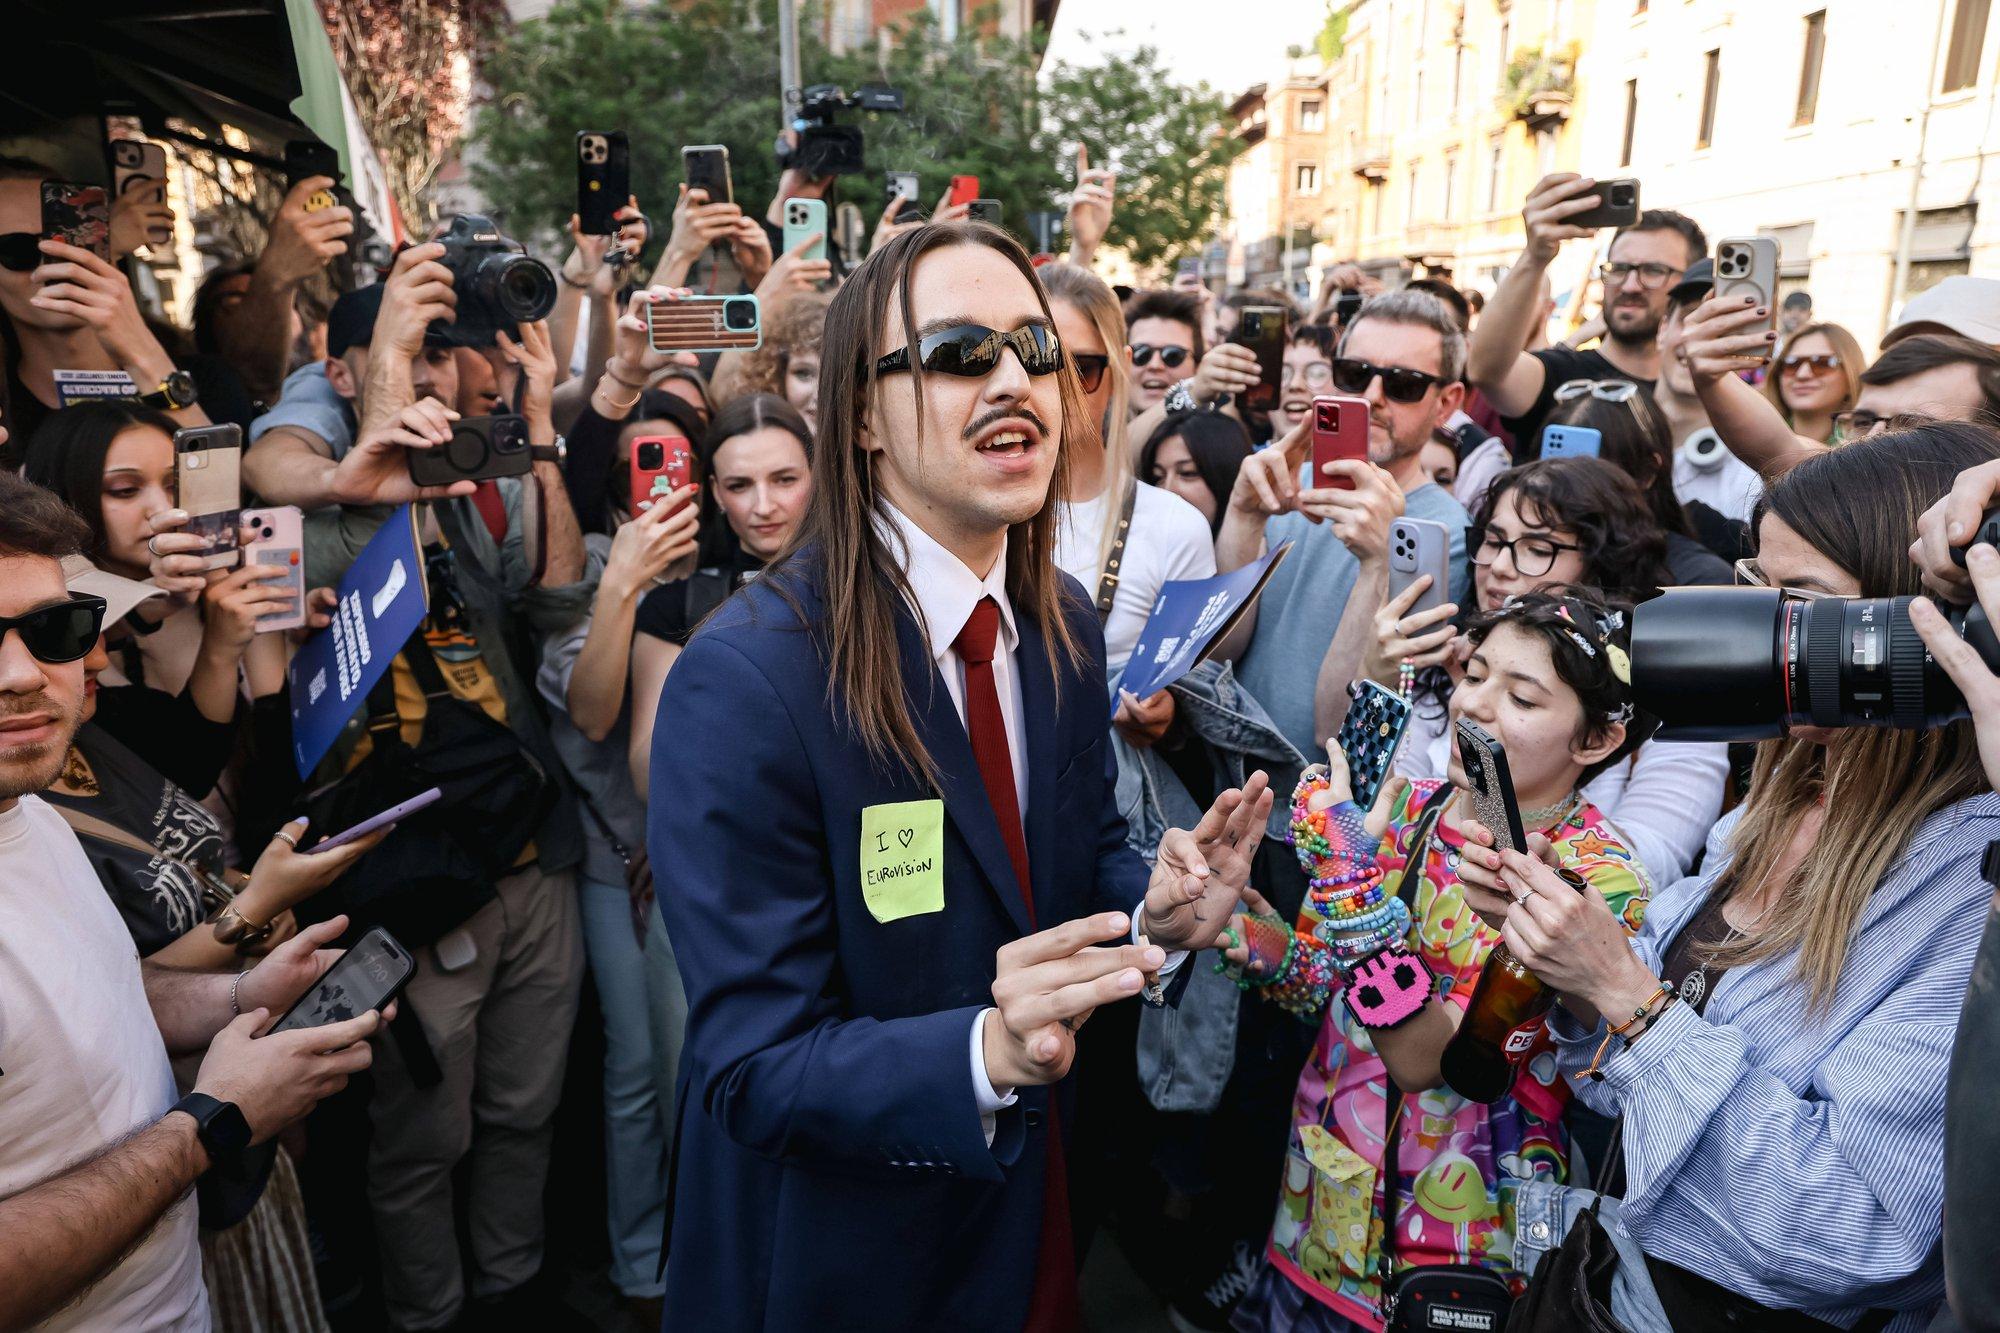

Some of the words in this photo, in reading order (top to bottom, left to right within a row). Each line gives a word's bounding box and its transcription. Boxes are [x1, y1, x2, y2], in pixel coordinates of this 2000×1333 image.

[876, 831, 890, 853] I
[1509, 1034, 1536, 1048] PE
[1432, 1309, 1461, 1321] HELLO
[1462, 1313, 1491, 1325] KITTY
[1432, 1316, 1453, 1326] AND
[1454, 1320, 1490, 1330] FRIENDS
